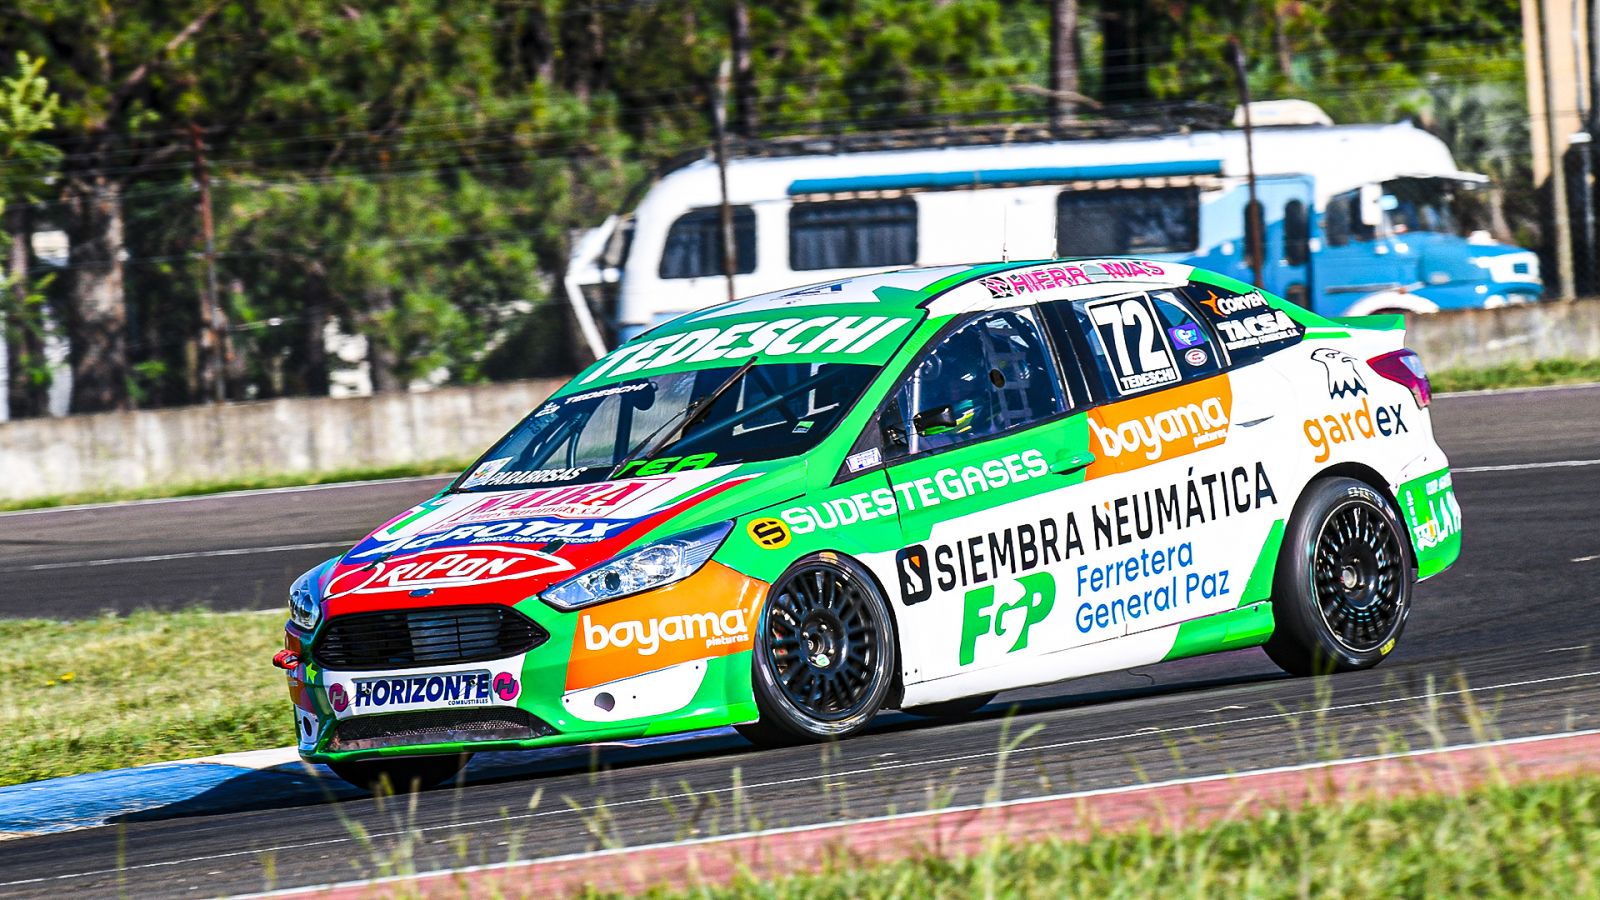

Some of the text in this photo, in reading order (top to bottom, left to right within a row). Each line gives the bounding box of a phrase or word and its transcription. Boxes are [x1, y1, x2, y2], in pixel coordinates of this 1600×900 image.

[1216, 289, 1270, 315] CORVEN
[1090, 299, 1172, 376] 72
[1216, 309, 1297, 341] TACSA
[579, 315, 912, 385] TEDESCHI
[564, 382, 649, 405] TEDESCHI
[1120, 368, 1176, 390] TEDESCHI
[1088, 396, 1230, 460] boyama
[1303, 397, 1408, 463] gardex
[484, 465, 588, 487] PARABRISAS
[351, 520, 630, 559] AGROTAX
[935, 461, 1278, 592] SIEMBRA NEUMÁTICA
[1076, 541, 1193, 598] Ferretera
[1075, 568, 1230, 634] General Paz
[582, 607, 749, 656] boyama
[355, 673, 490, 707] HORIZONTE
[447, 698, 489, 706] COMBUSTIBLES
